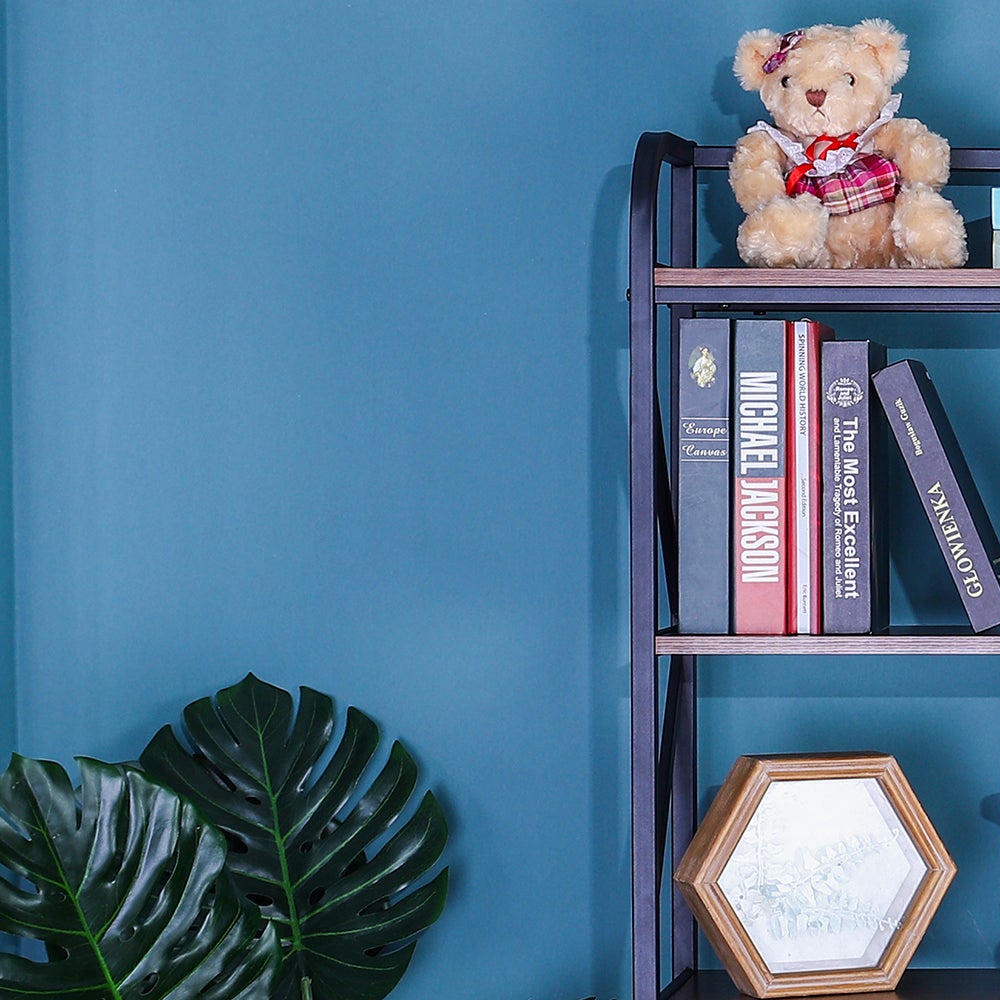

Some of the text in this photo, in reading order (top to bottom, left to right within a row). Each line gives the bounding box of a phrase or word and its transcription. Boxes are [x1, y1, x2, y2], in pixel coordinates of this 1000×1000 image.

[682, 422, 729, 438] Europe
[798, 334, 807, 436] SPINNING WORLD HISTORY
[895, 398, 909, 421] Guzik
[682, 444, 729, 457] Canvas
[739, 371, 780, 583] MICHAEL JACKSON
[832, 417, 843, 598] and Lamentable Tragedy of Romeo and Juliet
[842, 416, 860, 599] The Most Excellent
